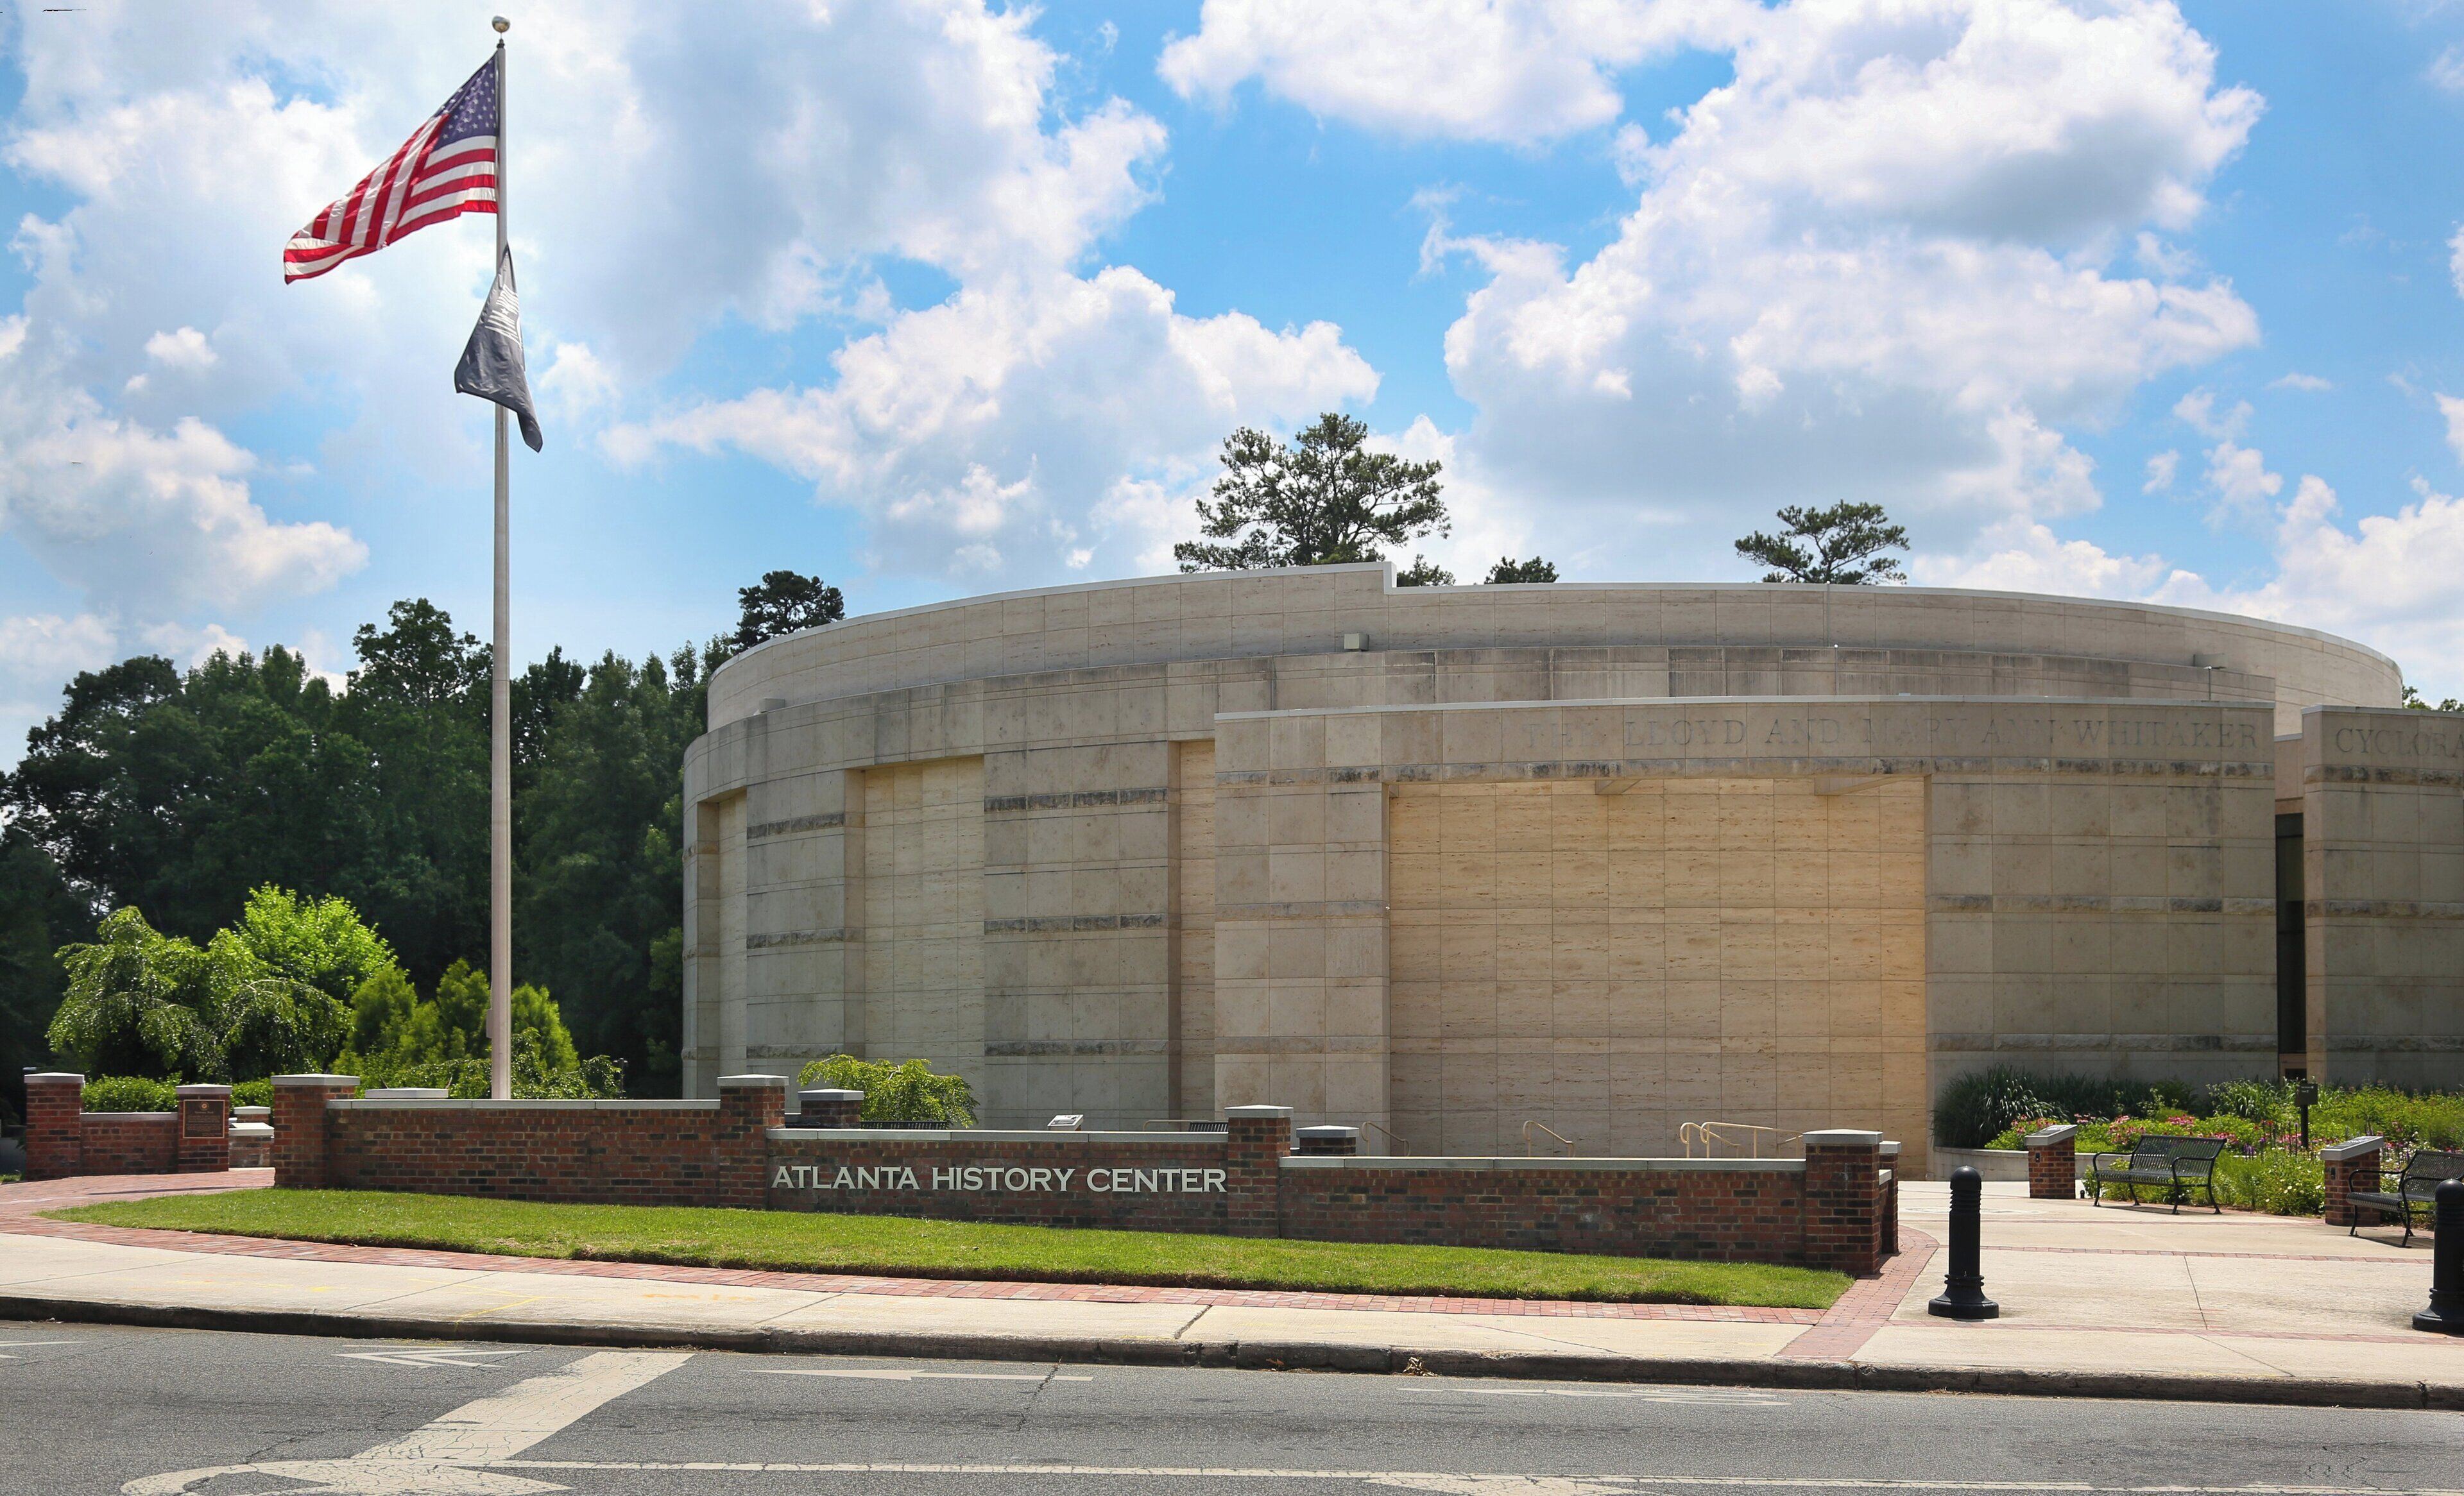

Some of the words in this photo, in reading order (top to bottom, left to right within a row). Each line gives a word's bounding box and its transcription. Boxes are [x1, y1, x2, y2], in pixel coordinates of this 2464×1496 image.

[1523, 722, 1600, 748] THE
[1625, 719, 1747, 746] LLOYD
[1765, 718, 1840, 744] AND
[1862, 717, 1968, 744] MARY
[1981, 718, 2057, 744] ANN
[2073, 719, 2258, 749] WHITAKER
[771, 1166, 921, 1190] ATLANTA
[932, 1167, 1076, 1192] HISTORY
[1086, 1168, 1228, 1193] CENTER
